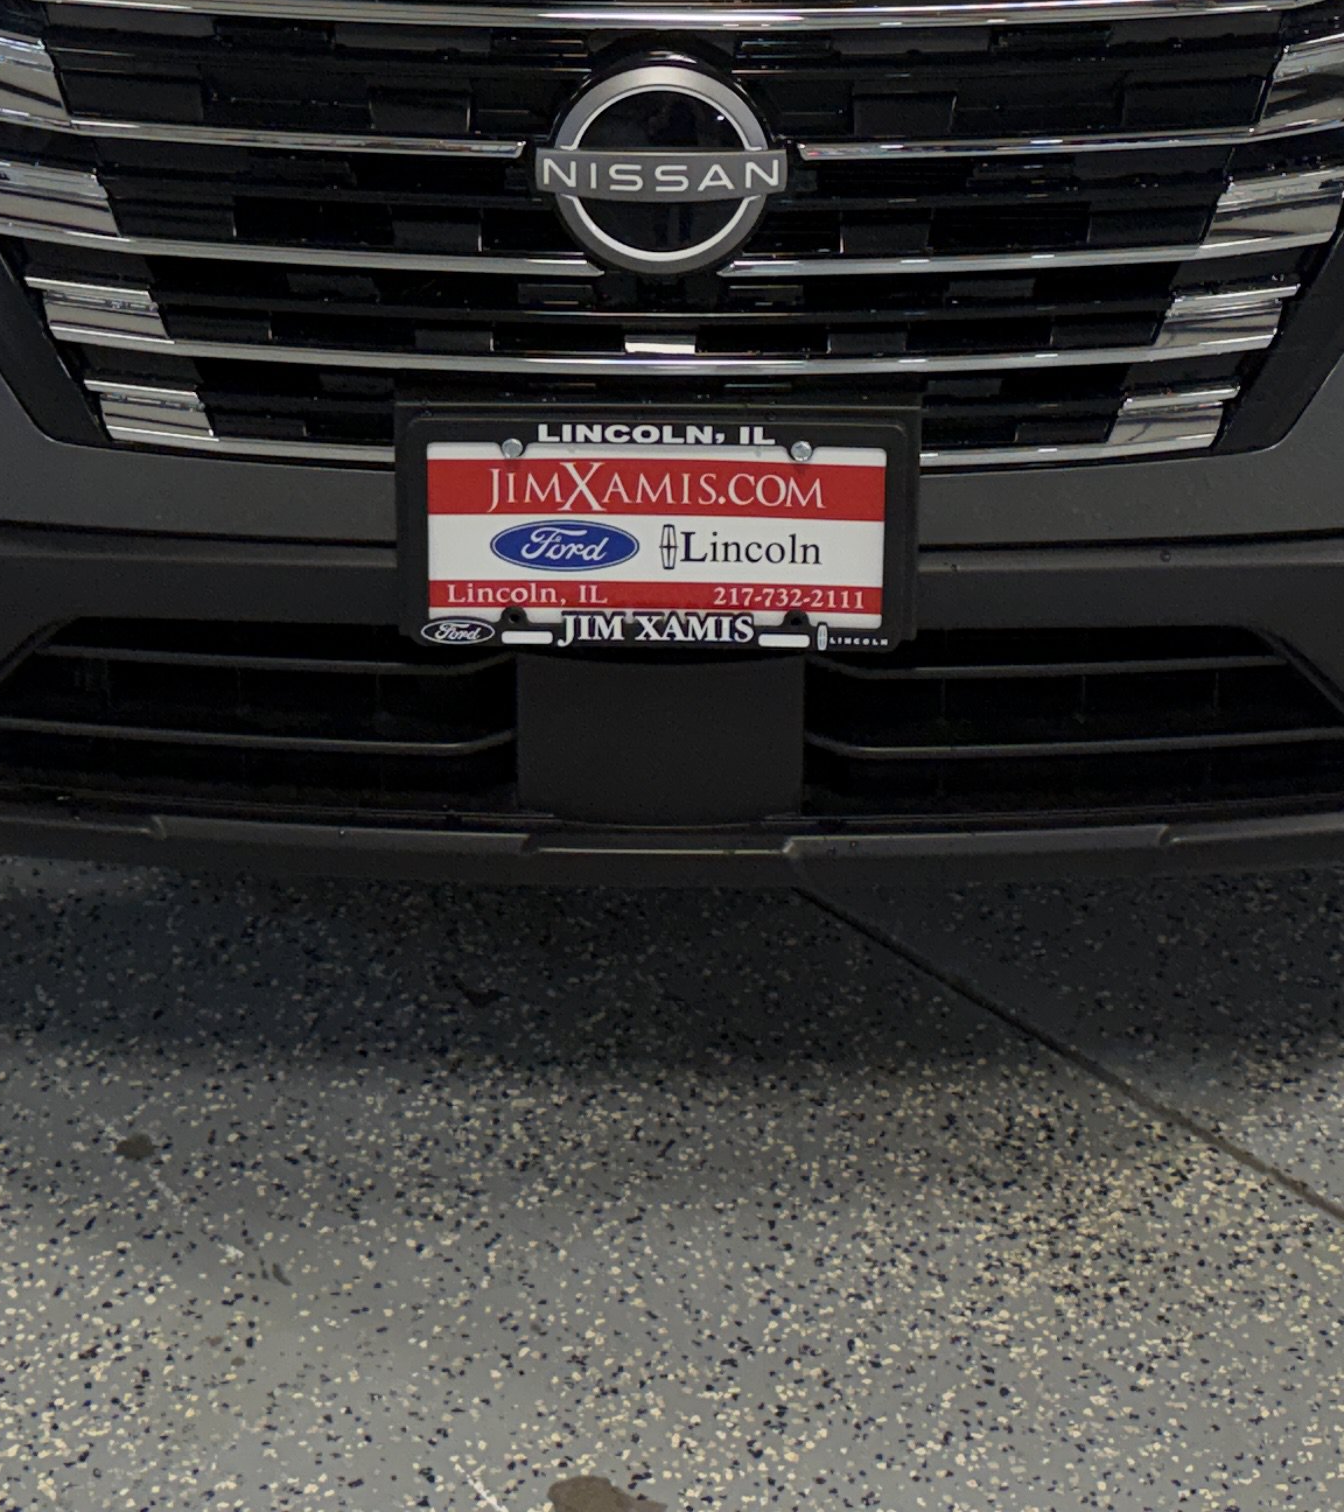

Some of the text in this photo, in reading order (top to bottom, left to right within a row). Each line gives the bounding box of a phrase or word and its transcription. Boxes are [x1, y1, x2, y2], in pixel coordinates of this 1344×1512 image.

[543, 158, 779, 192] NISSAN
[537, 423, 776, 446] LINCOLN, IL
[520, 525, 610, 563] Ford
[679, 531, 822, 565] Lincoln
[447, 583, 608, 606] Lincoln, IL
[713, 586, 865, 610] 217-732-2111
[434, 622, 482, 641] Ford
[556, 614, 755, 648] JIM XAMIS
[829, 636, 889, 646] LINCOLN
